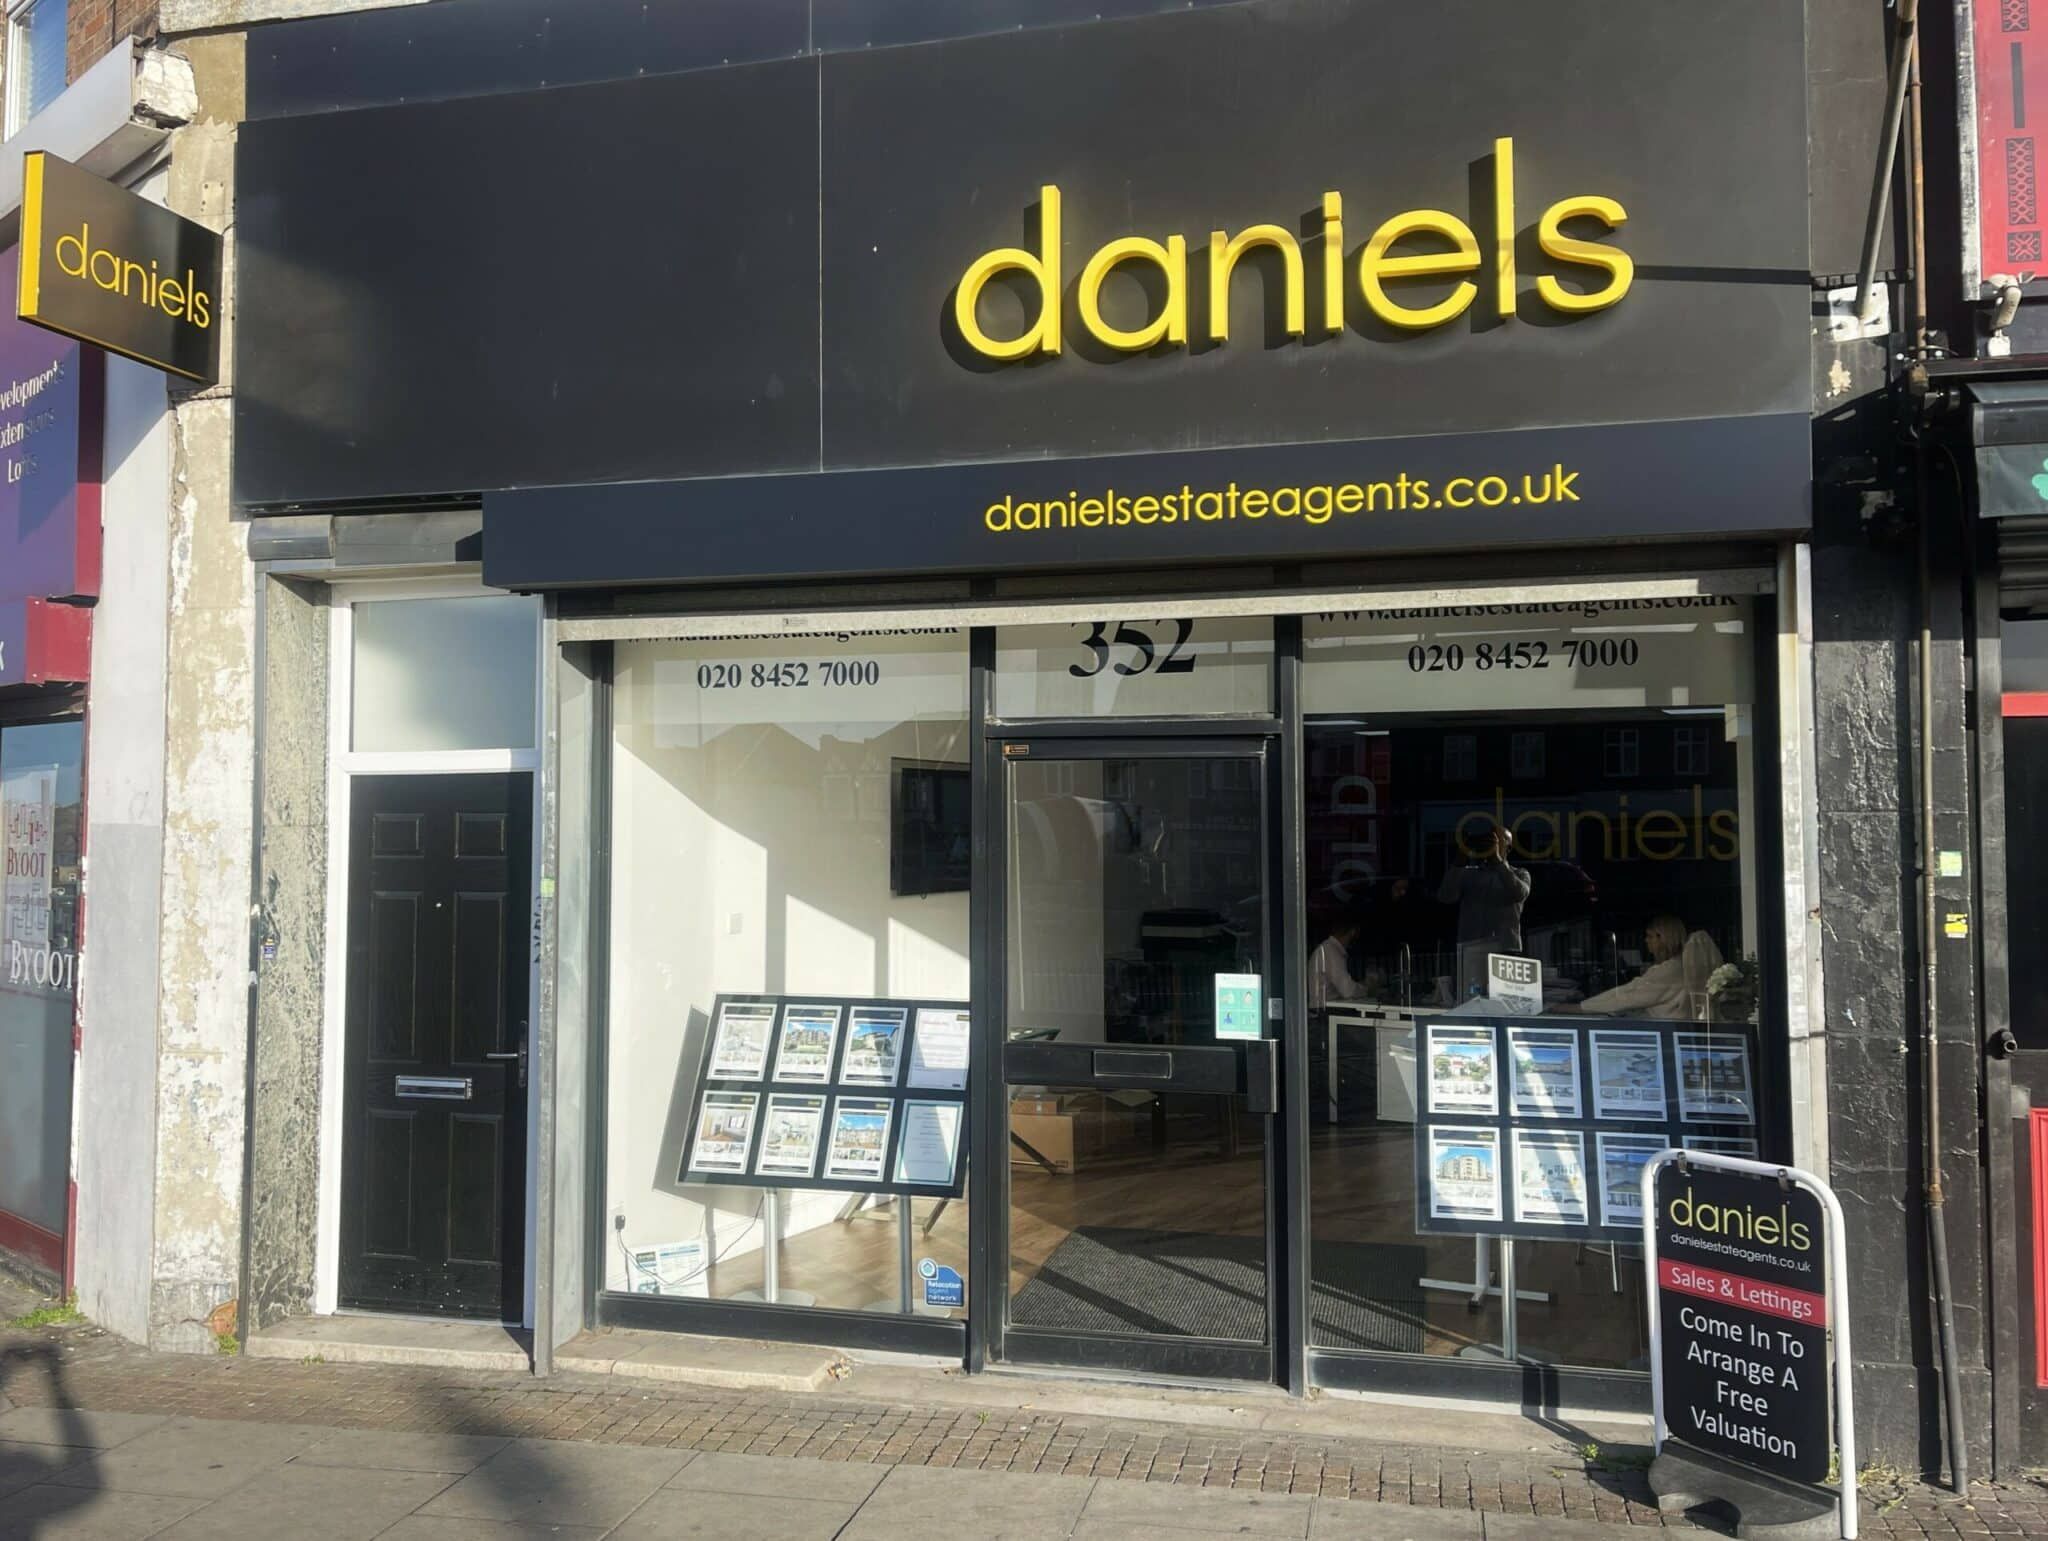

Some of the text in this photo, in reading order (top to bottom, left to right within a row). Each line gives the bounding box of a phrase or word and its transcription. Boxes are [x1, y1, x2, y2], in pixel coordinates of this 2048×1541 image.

[954, 136, 1636, 358] daniels
[56, 223, 210, 328] daniels
[984, 463, 1580, 532] danielsestateagents.co.uk
[1069, 618, 1197, 677] 352
[1408, 638, 1639, 672] 020 8452 7000
[697, 660, 880, 689] 020 8452 7000
[1454, 784, 1739, 862] daniels
[1497, 959, 1532, 983] FREE
[1669, 1186, 1811, 1251] daniels
[1670, 1233, 1812, 1273] danielsestateagents.co.uk
[1671, 1267, 1812, 1319] Sales & Lettings
[1680, 1307, 1804, 1358] Come In To
[1687, 1341, 1799, 1391] Arrange A
[1717, 1380, 1768, 1416] Free
[1691, 1405, 1797, 1460] Valuation
